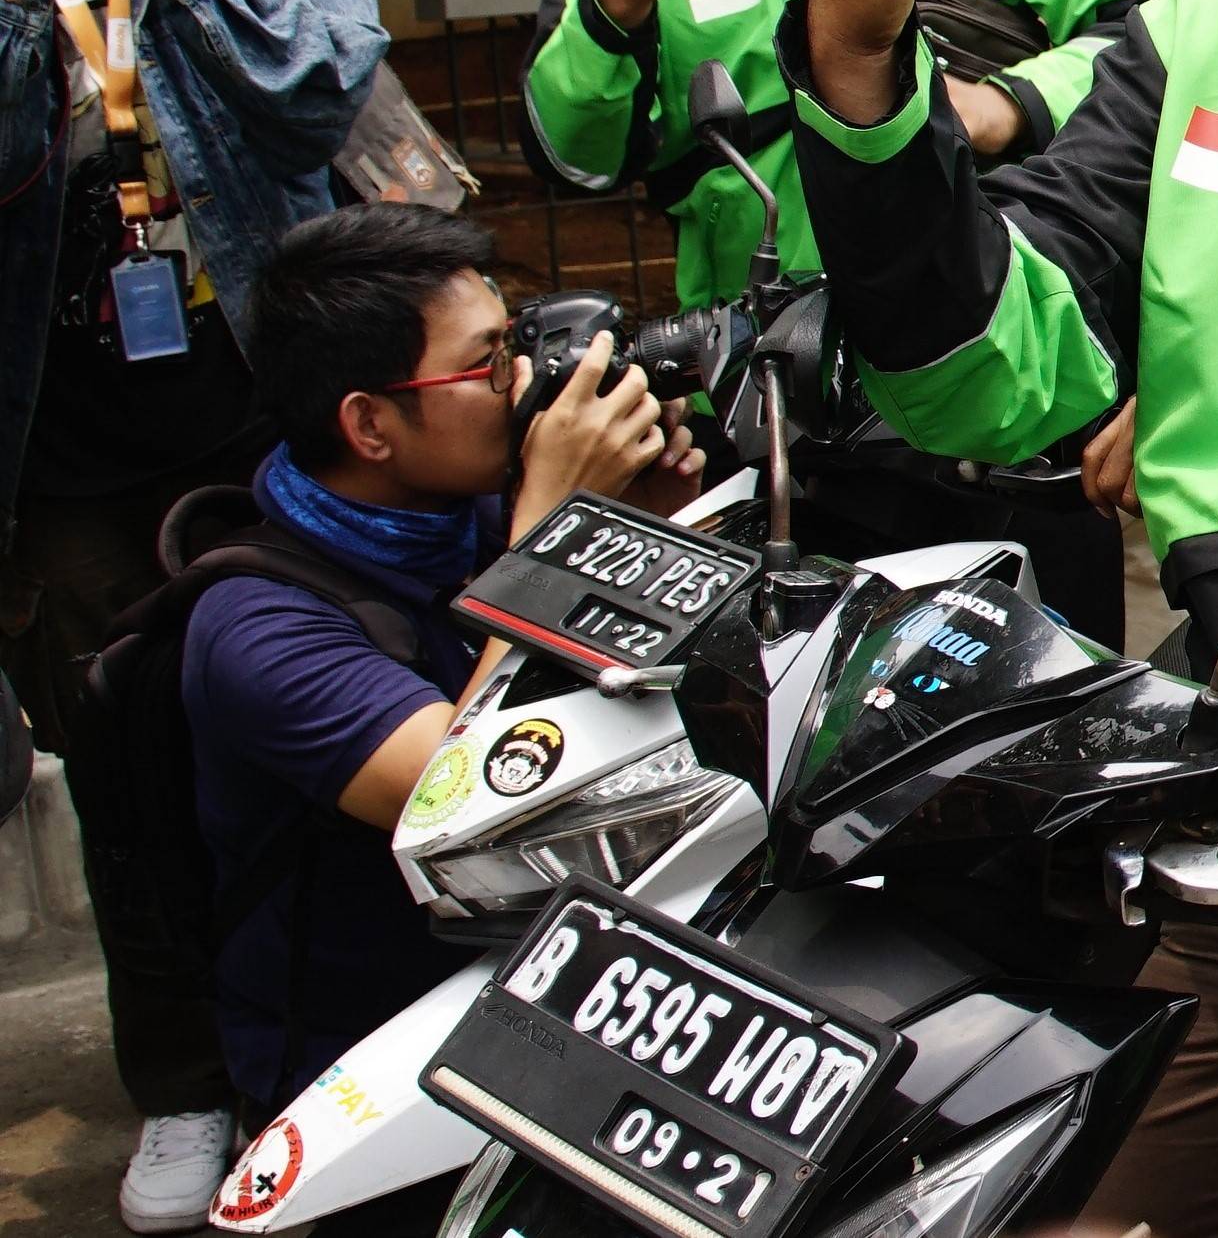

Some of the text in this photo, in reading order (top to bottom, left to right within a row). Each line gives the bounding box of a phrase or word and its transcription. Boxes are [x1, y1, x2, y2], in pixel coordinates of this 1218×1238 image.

[533, 513, 730, 613] B 3226 PES
[932, 590, 1009, 627] HONDA
[505, 926, 580, 1003] B
[574, 956, 733, 1075] 6595
